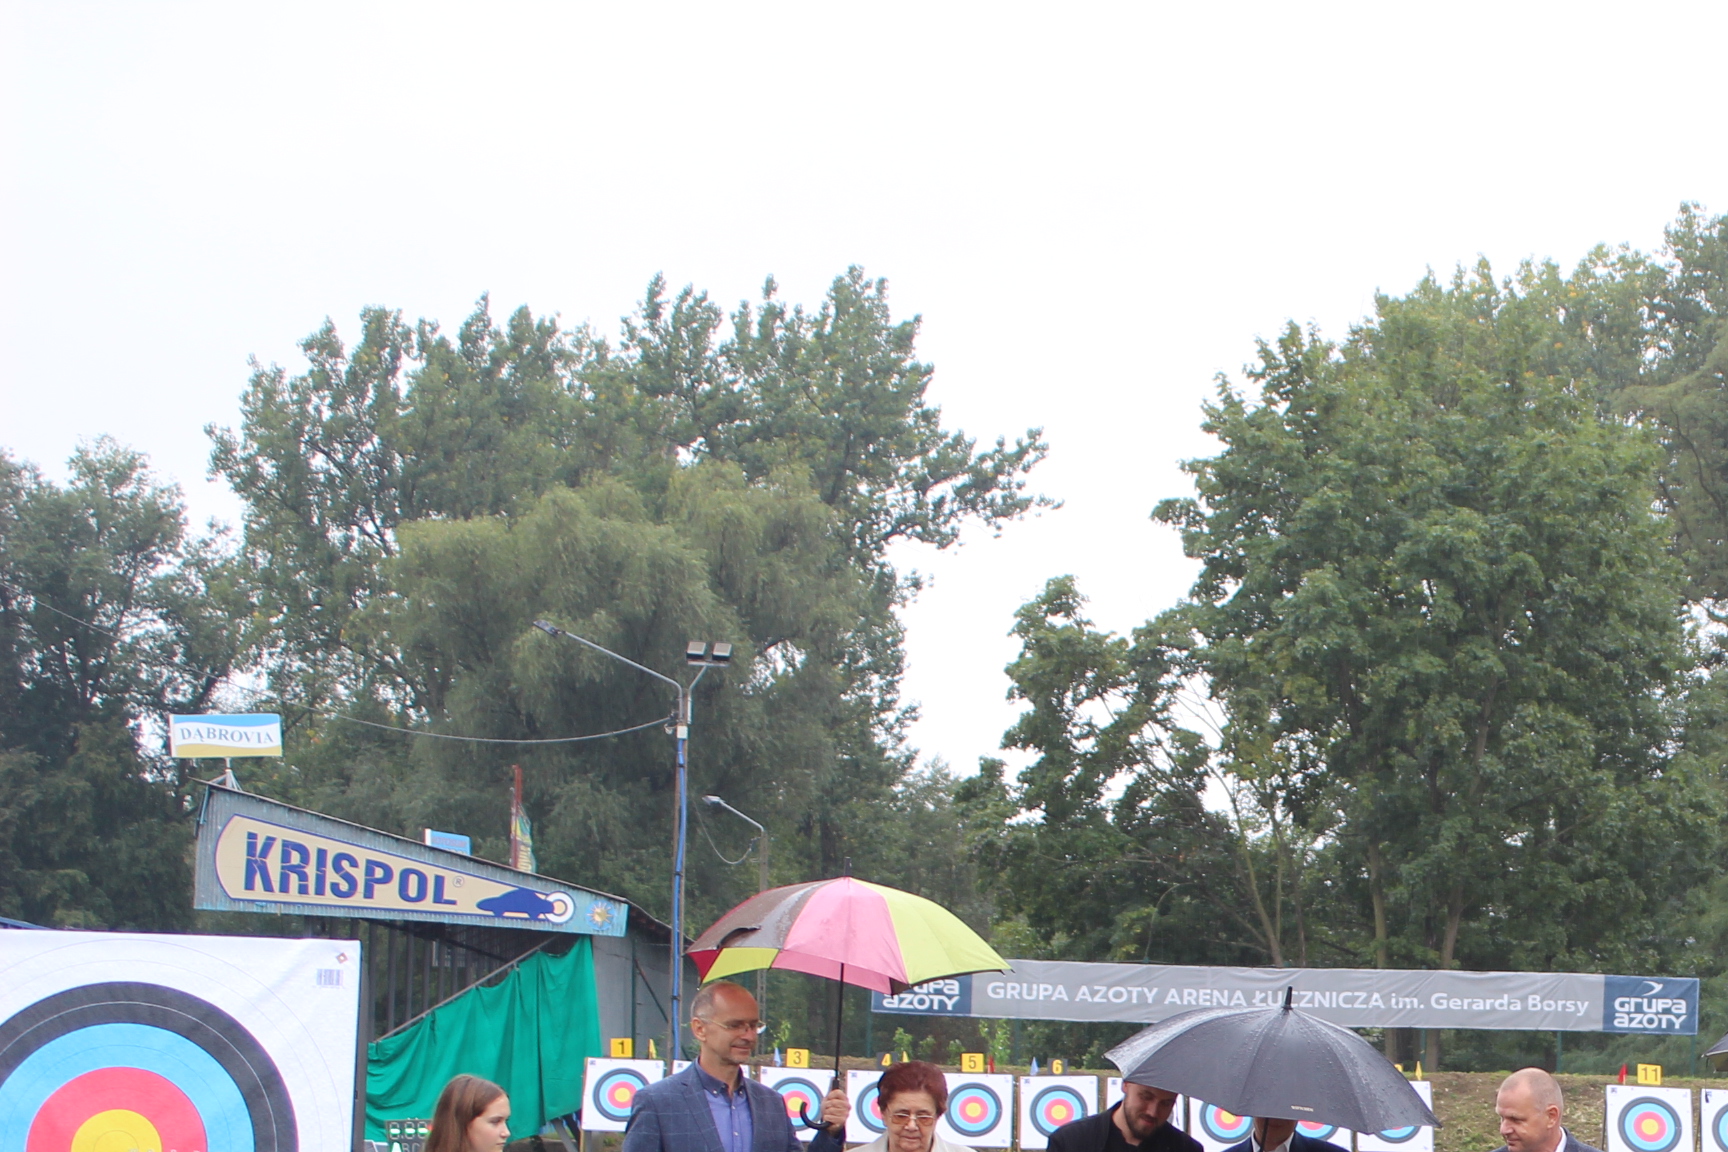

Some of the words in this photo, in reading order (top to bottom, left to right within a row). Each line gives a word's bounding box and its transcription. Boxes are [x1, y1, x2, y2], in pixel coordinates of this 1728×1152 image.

[180, 727, 274, 744] DĄBROVIA
[244, 831, 457, 905] KRISPOL
[987, 981, 1068, 1002] GRUPA
[1075, 985, 1159, 1004] AZOTY
[1164, 988, 1246, 1008] ARENA
[1391, 993, 1424, 1010] im.
[1430, 992, 1521, 1012] Gerarda
[1528, 994, 1589, 1016] Borsy
[618, 1041, 625, 1054] 1
[793, 1051, 802, 1064] 3
[881, 1054, 891, 1066] 4
[968, 1056, 976, 1069] 5
[1052, 1060, 1062, 1074] 6
[1641, 1067, 1659, 1082] 11
